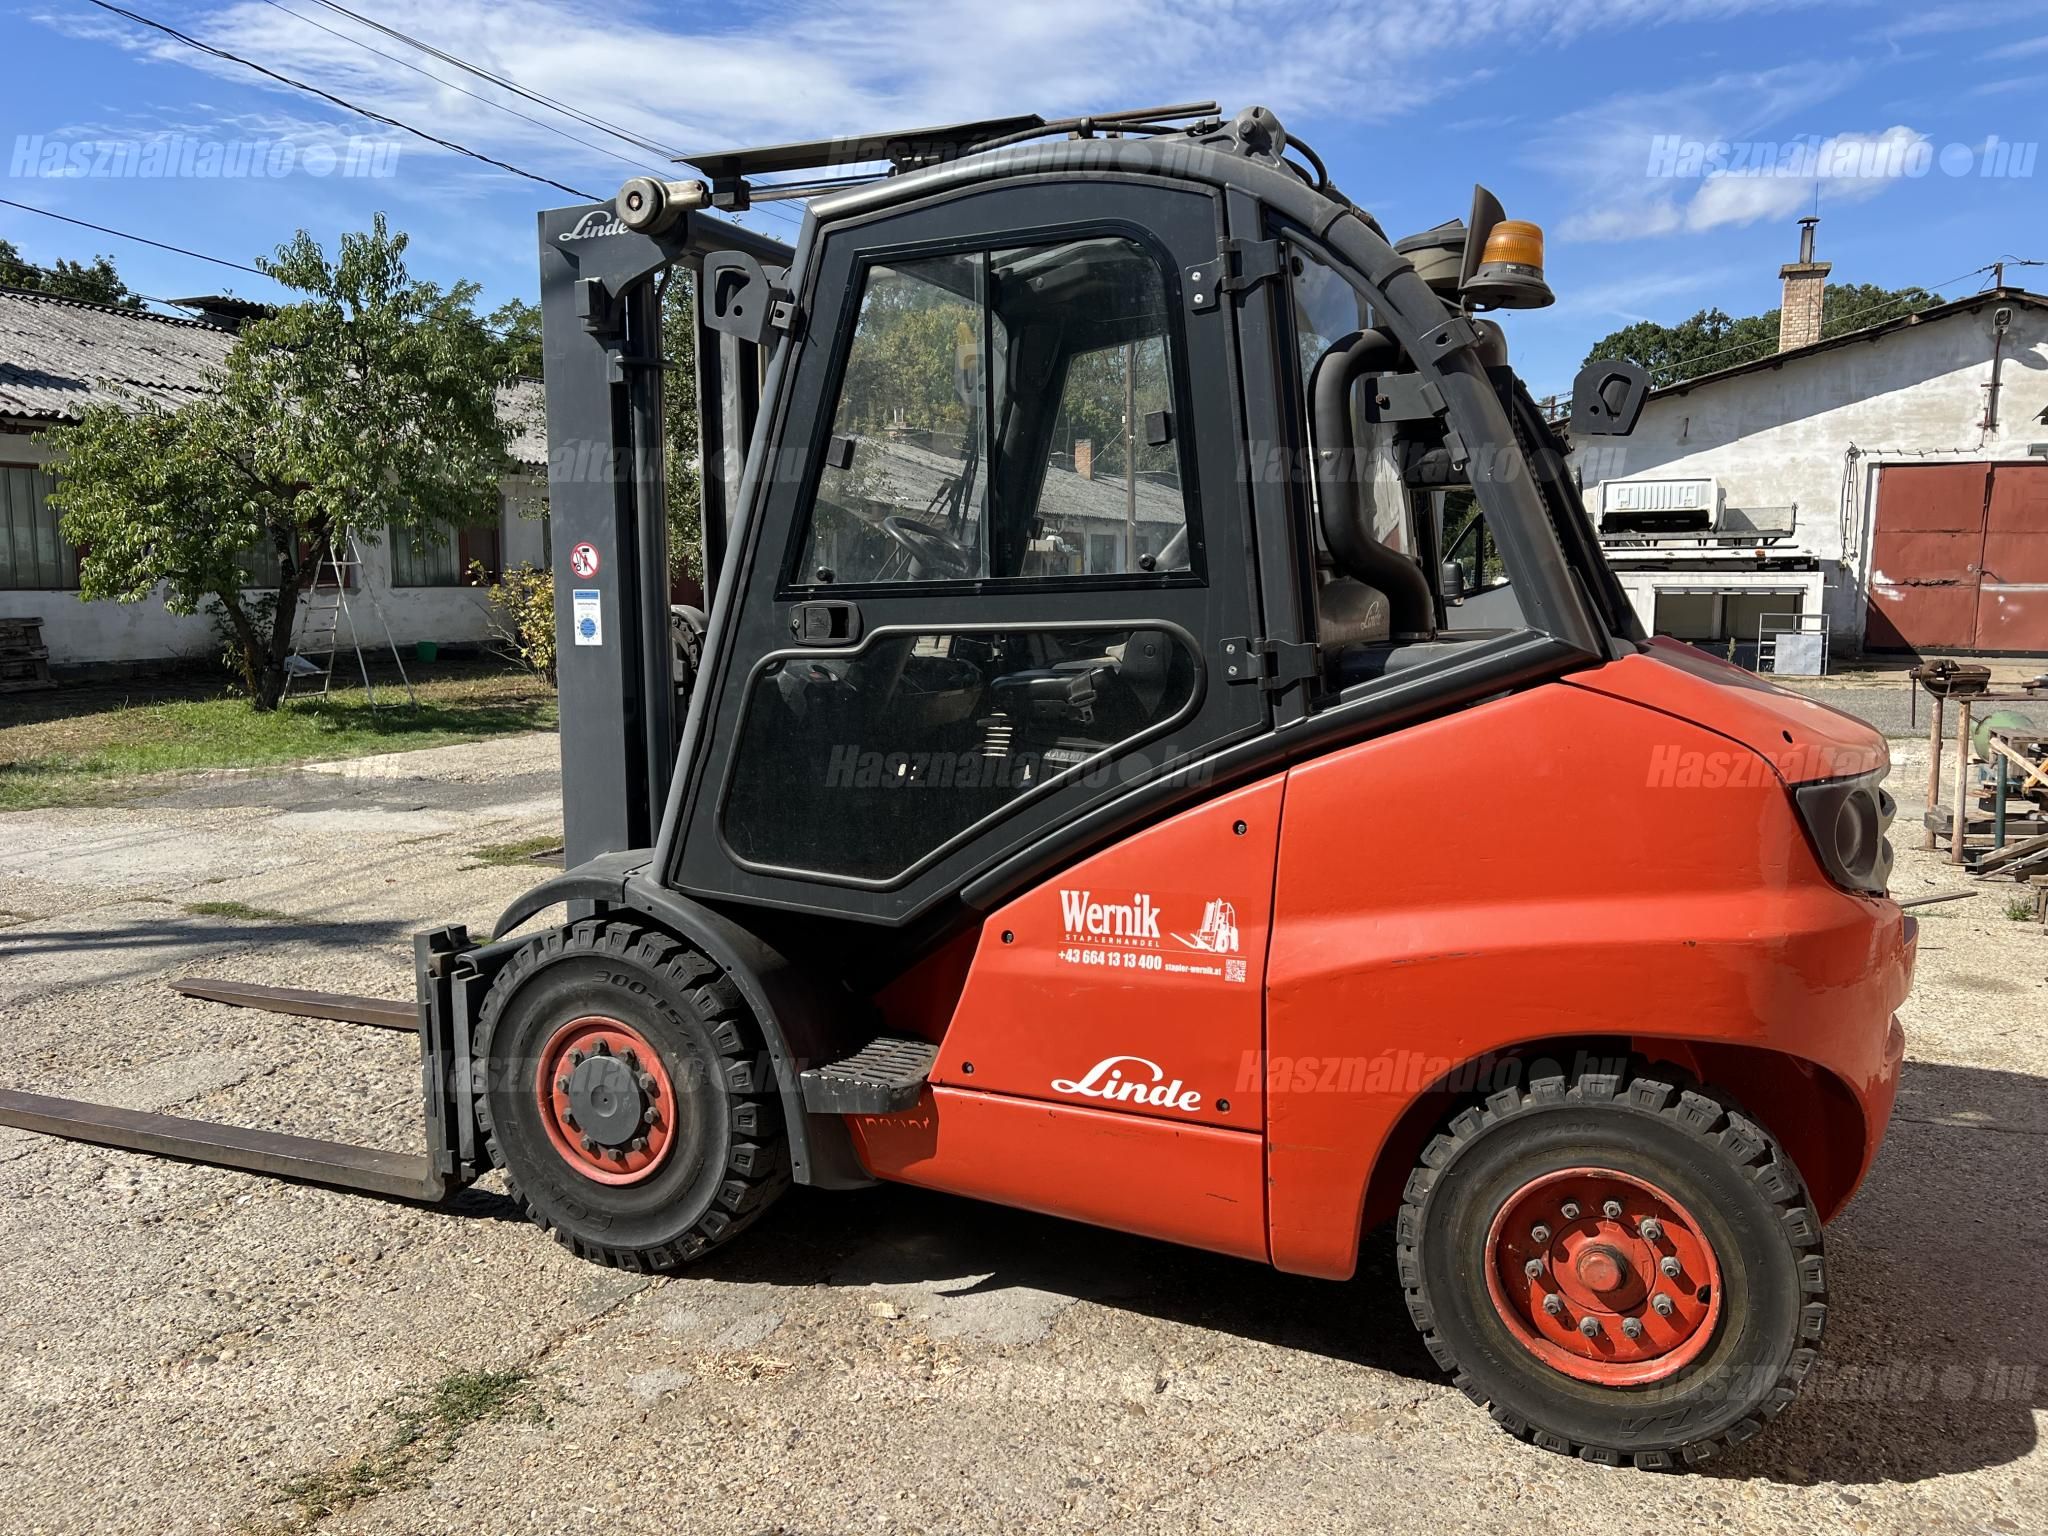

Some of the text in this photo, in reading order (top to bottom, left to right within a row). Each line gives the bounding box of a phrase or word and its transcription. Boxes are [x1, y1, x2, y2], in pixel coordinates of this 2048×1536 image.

[558, 210, 631, 241] Linde
[1060, 889, 1161, 938] Wernik
[1065, 933, 1160, 948] STAPLERHANDEL
[1058, 948, 1222, 976] +43 664 13 13 400 stapler-wernik.at
[1051, 1055, 1201, 1112] Linde
